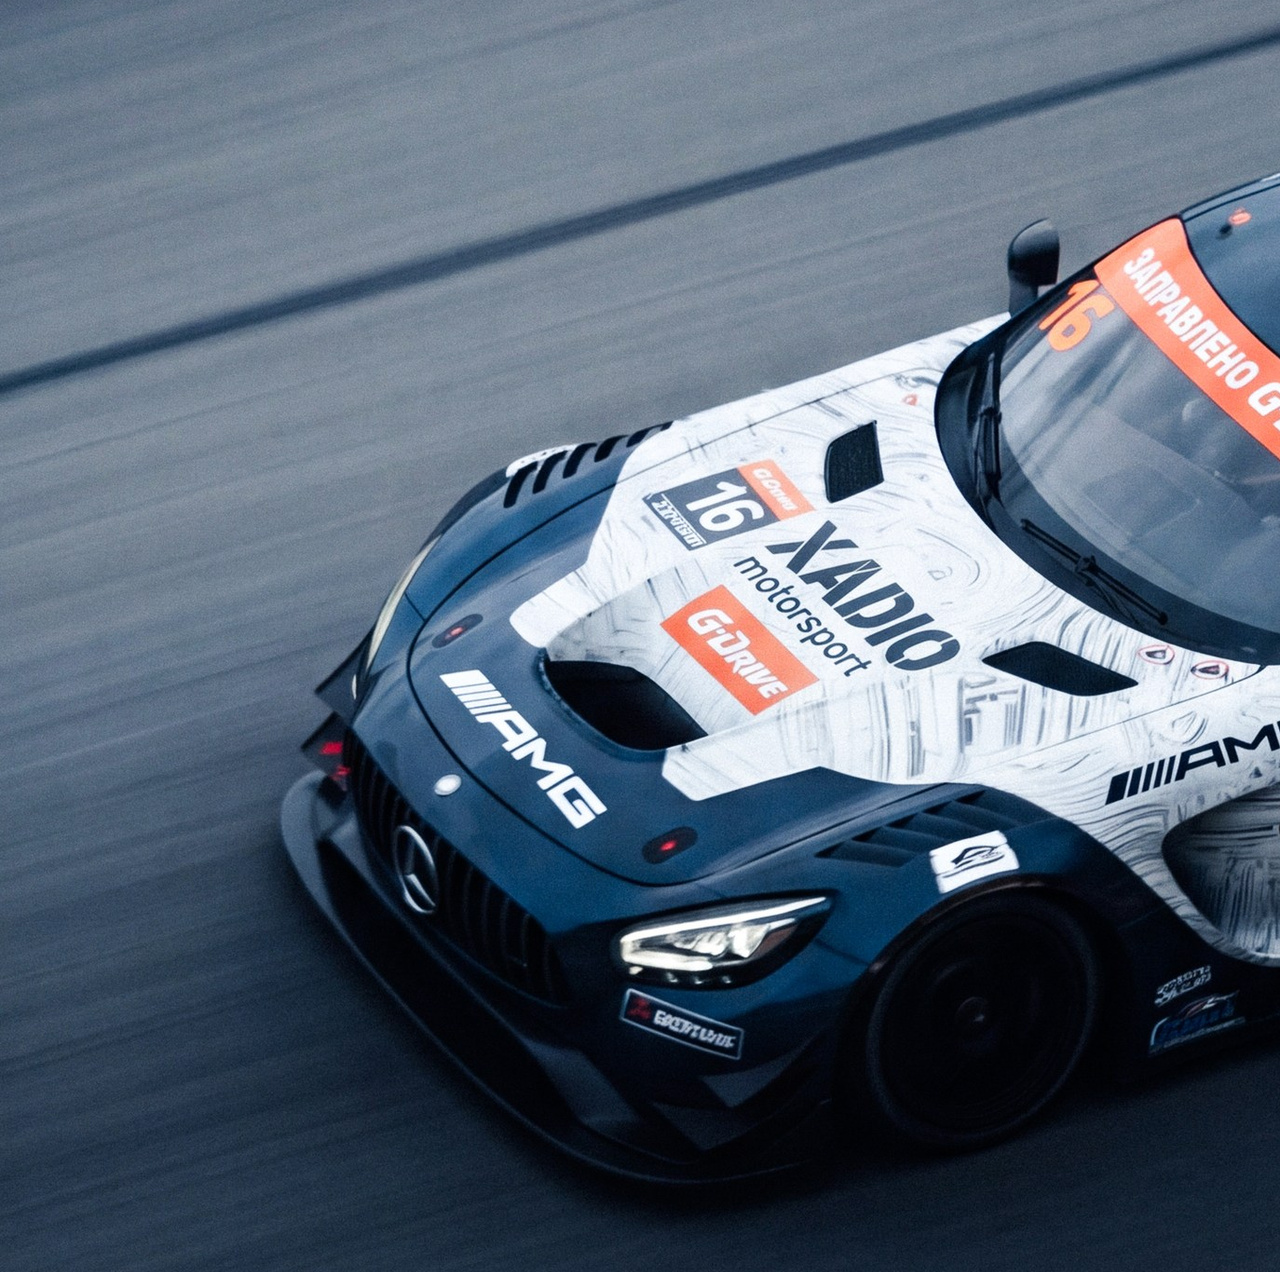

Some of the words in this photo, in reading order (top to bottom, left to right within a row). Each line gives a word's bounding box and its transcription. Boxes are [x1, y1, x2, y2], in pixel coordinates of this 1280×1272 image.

[1038, 279, 1116, 352] 16
[1122, 248, 1260, 390] ЗАПРАВЛЕНО
[685, 481, 765, 532] 16
[687, 608, 789, 700] G-DRIVE
[734, 556, 870, 677] motorsport
[765, 520, 961, 671] XADIO
[474, 710, 608, 829] AMG
